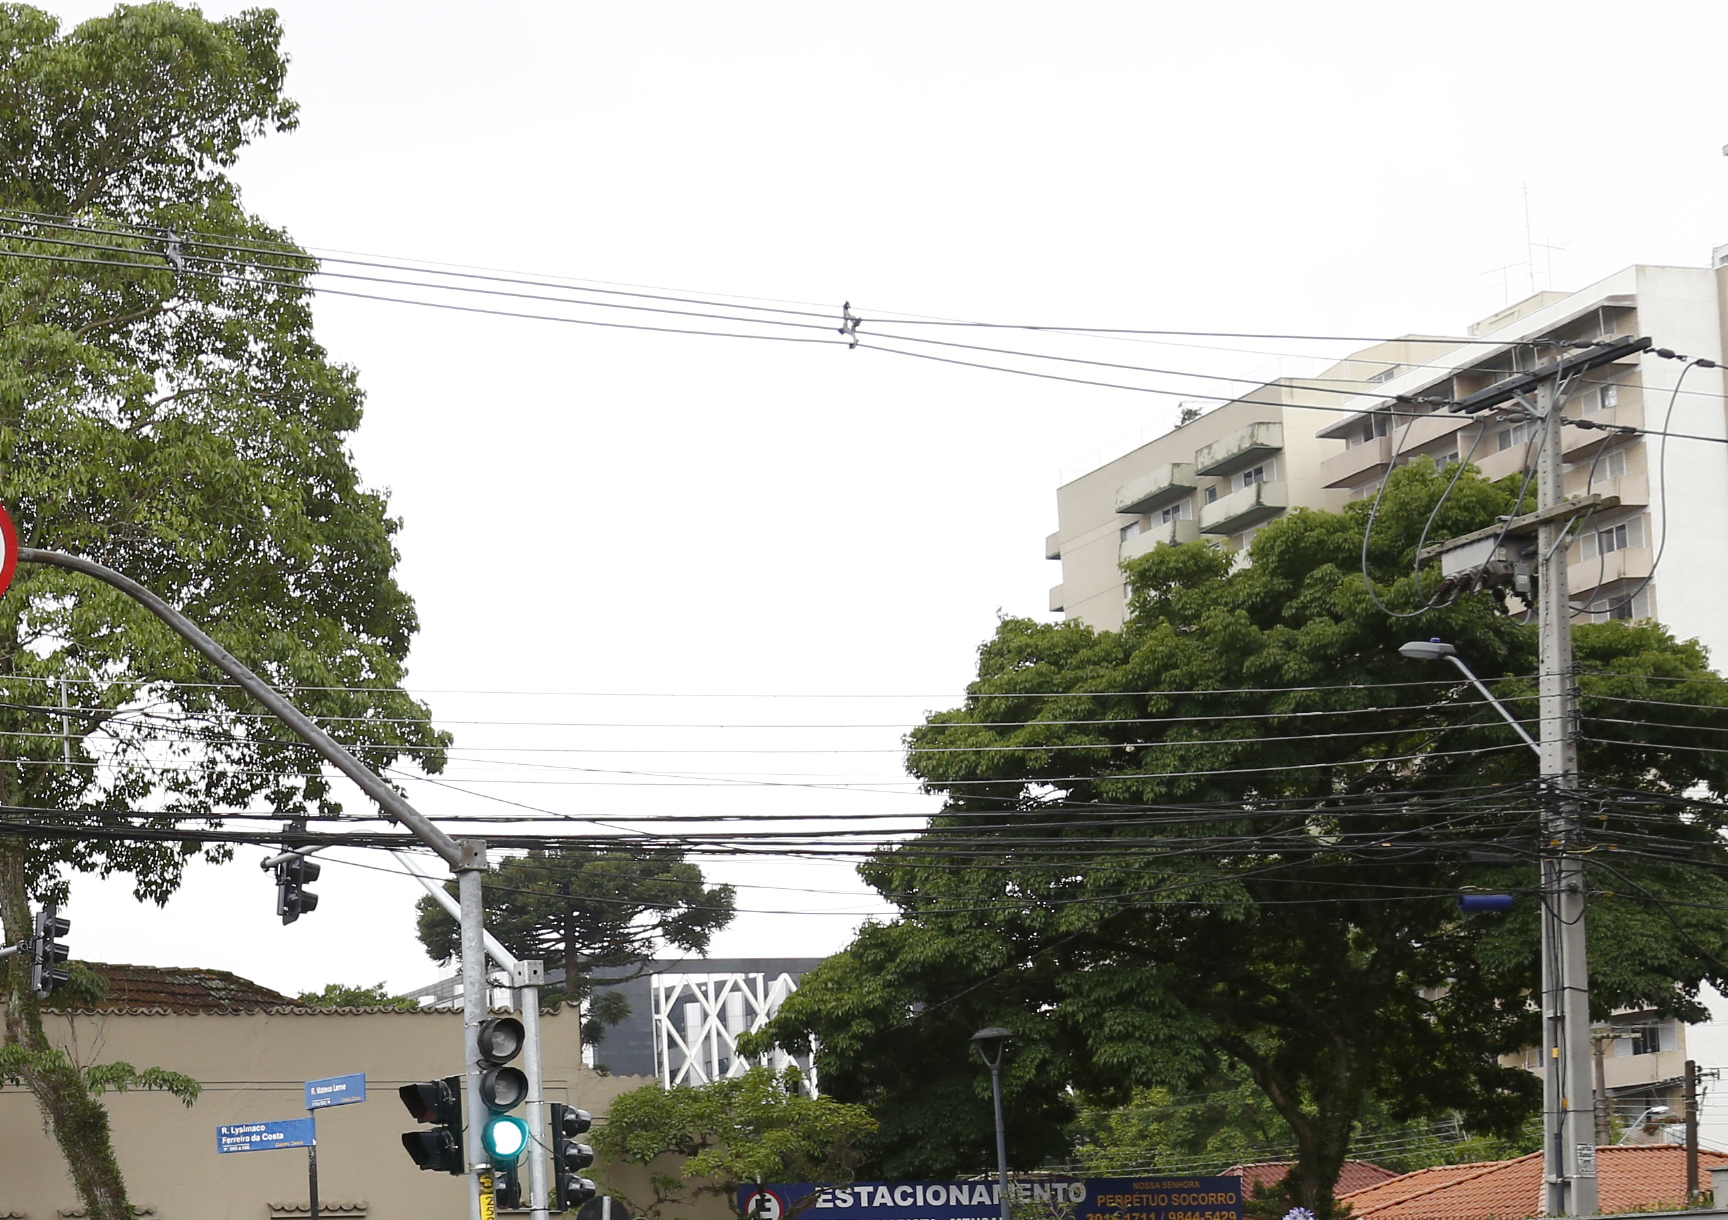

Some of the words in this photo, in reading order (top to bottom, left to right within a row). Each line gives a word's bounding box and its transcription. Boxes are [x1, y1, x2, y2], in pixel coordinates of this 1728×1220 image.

[310, 1087, 316, 1095] R.
[332, 1083, 347, 1092] Leme
[230, 1125, 265, 1135] Lysimaco
[222, 1135, 250, 1144] Ferreira
[262, 1132, 284, 1141] Costa
[1133, 1181, 1161, 1190] NOSSA
[1162, 1180, 1200, 1189] SENHORA
[815, 1182, 1087, 1208] ESTACIONAMENTO
[1097, 1191, 1168, 1207] PERPÉTUO
[1171, 1192, 1236, 1206] SOCORRO
